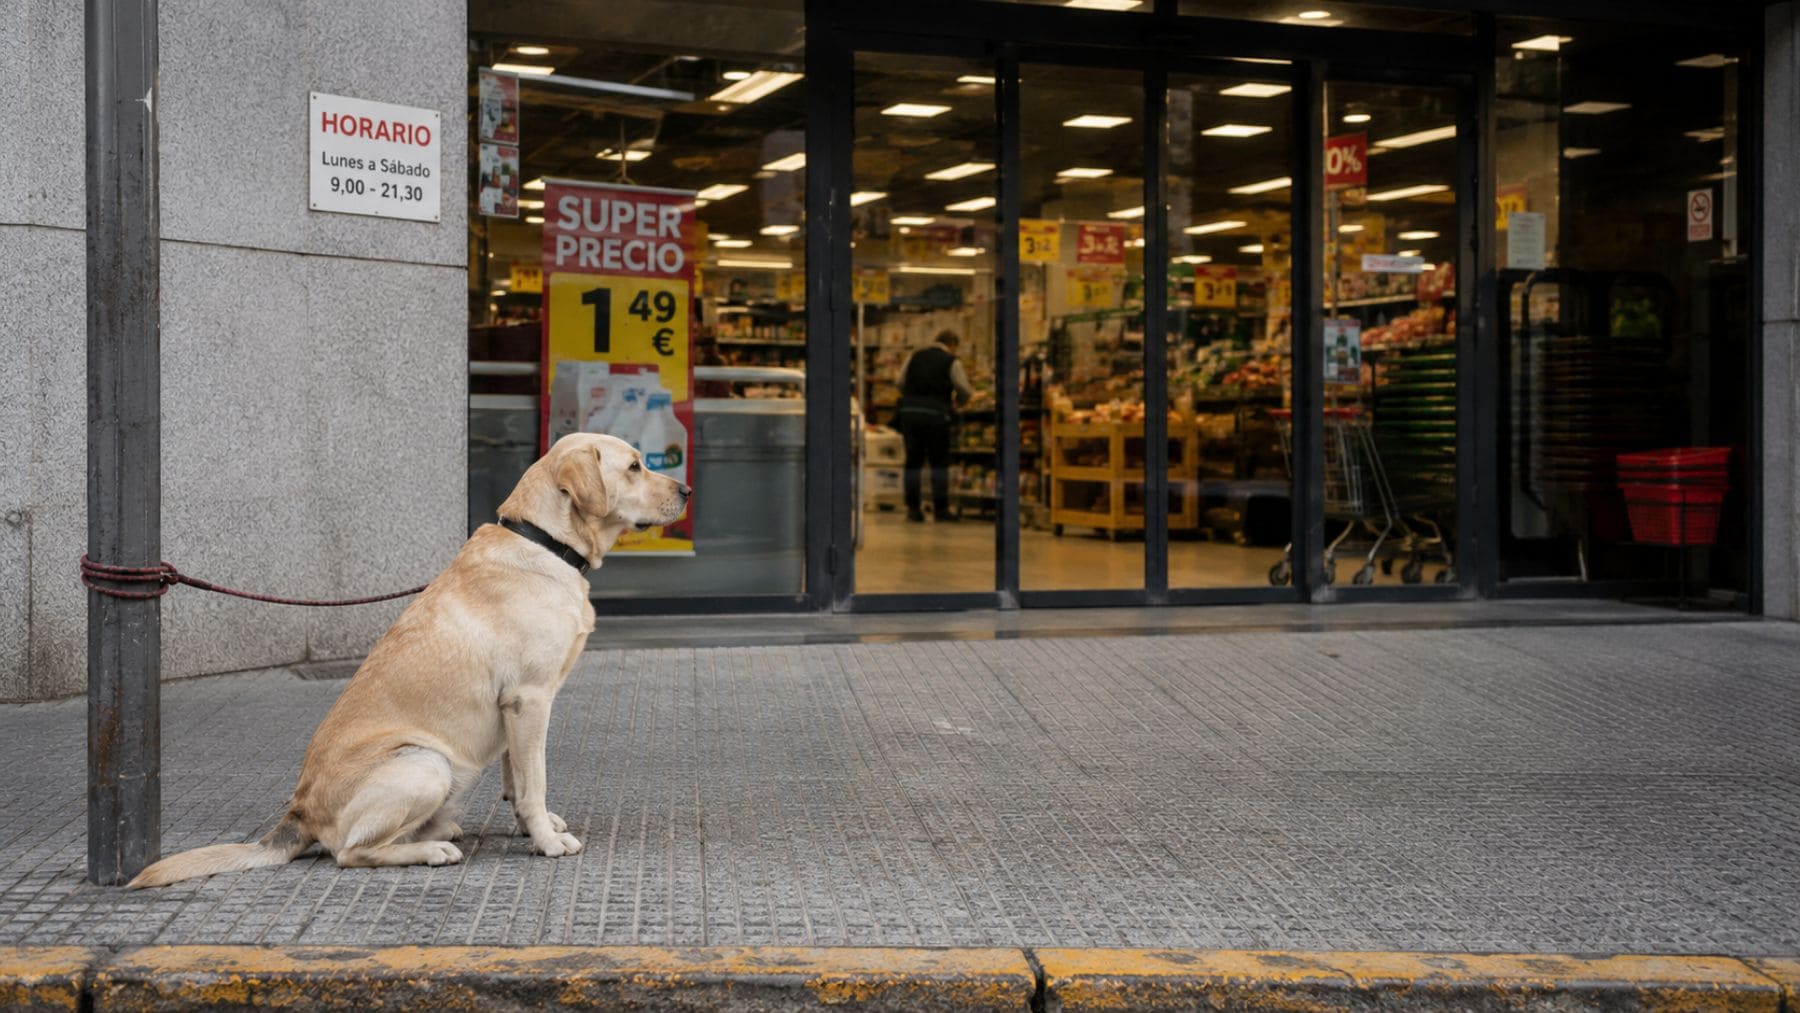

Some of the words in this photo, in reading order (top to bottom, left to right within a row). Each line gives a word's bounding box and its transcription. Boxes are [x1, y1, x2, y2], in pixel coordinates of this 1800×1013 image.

[322, 111, 431, 147] HORARIO
[322, 151, 364, 170] Lunes
[368, 160, 376, 171] a
[380, 158, 431, 178] Sábado
[330, 176, 365, 195] 9,00
[381, 182, 423, 202] 21,30
[557, 195, 682, 238] SUPER
[555, 234, 685, 274] PRECIO
[581, 287, 612, 353] 1
[628, 290, 677, 323] 49
[652, 327, 675, 357] €
